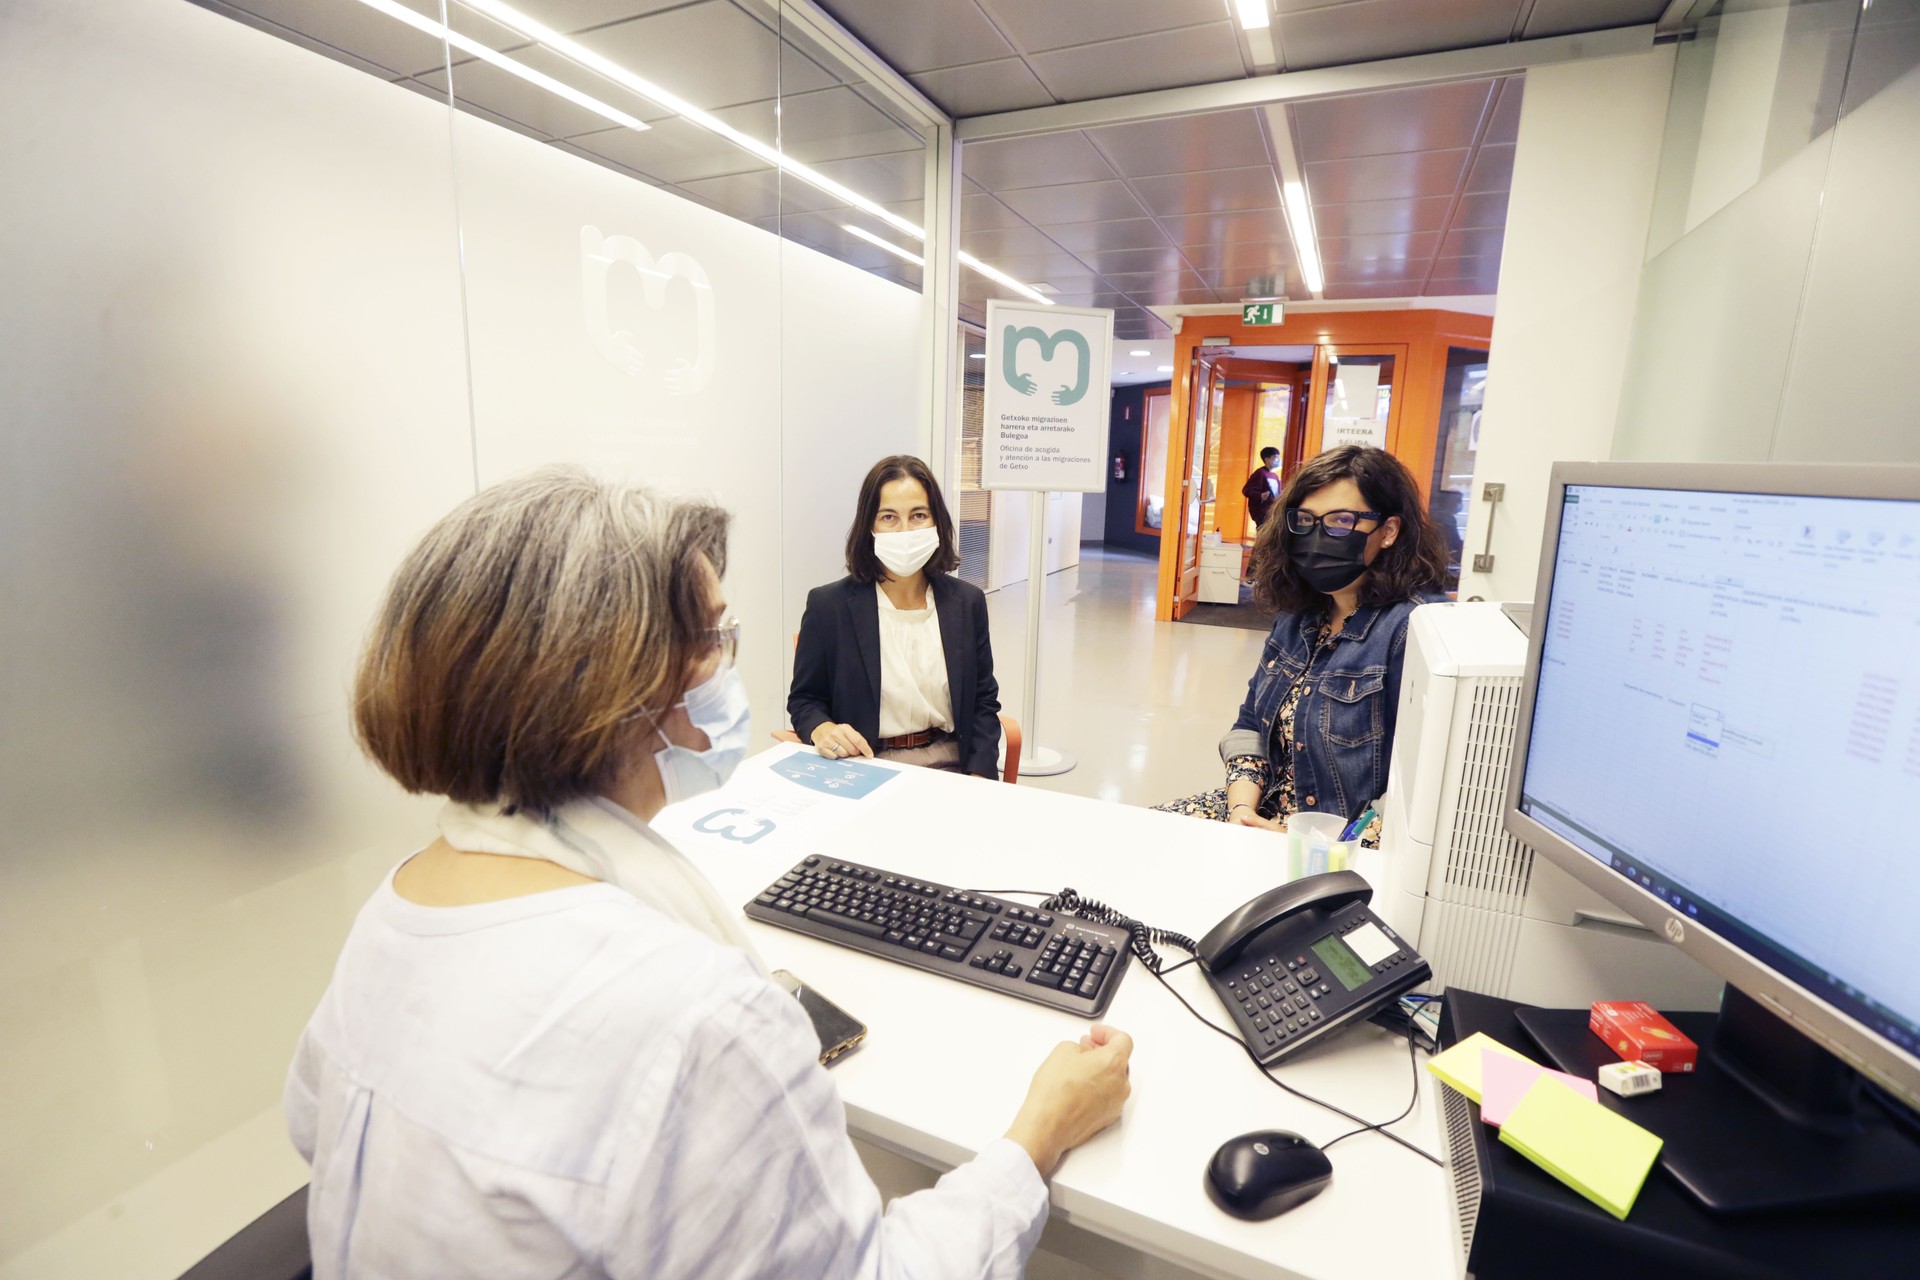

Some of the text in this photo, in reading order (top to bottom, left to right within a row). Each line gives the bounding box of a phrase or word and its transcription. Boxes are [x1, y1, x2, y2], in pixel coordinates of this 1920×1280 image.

[1001, 413, 1068, 424] Getxoko migrazioen
[1000, 423, 1026, 431] harrera
[1040, 425, 1075, 433] arretarako
[1000, 431, 1029, 440] Bulegoa
[1000, 444, 1060, 455] Oficina de acogida
[1005, 453, 1034, 462] atención
[1052, 456, 1091, 464] migraciones
[1009, 462, 1029, 470] Getxo
